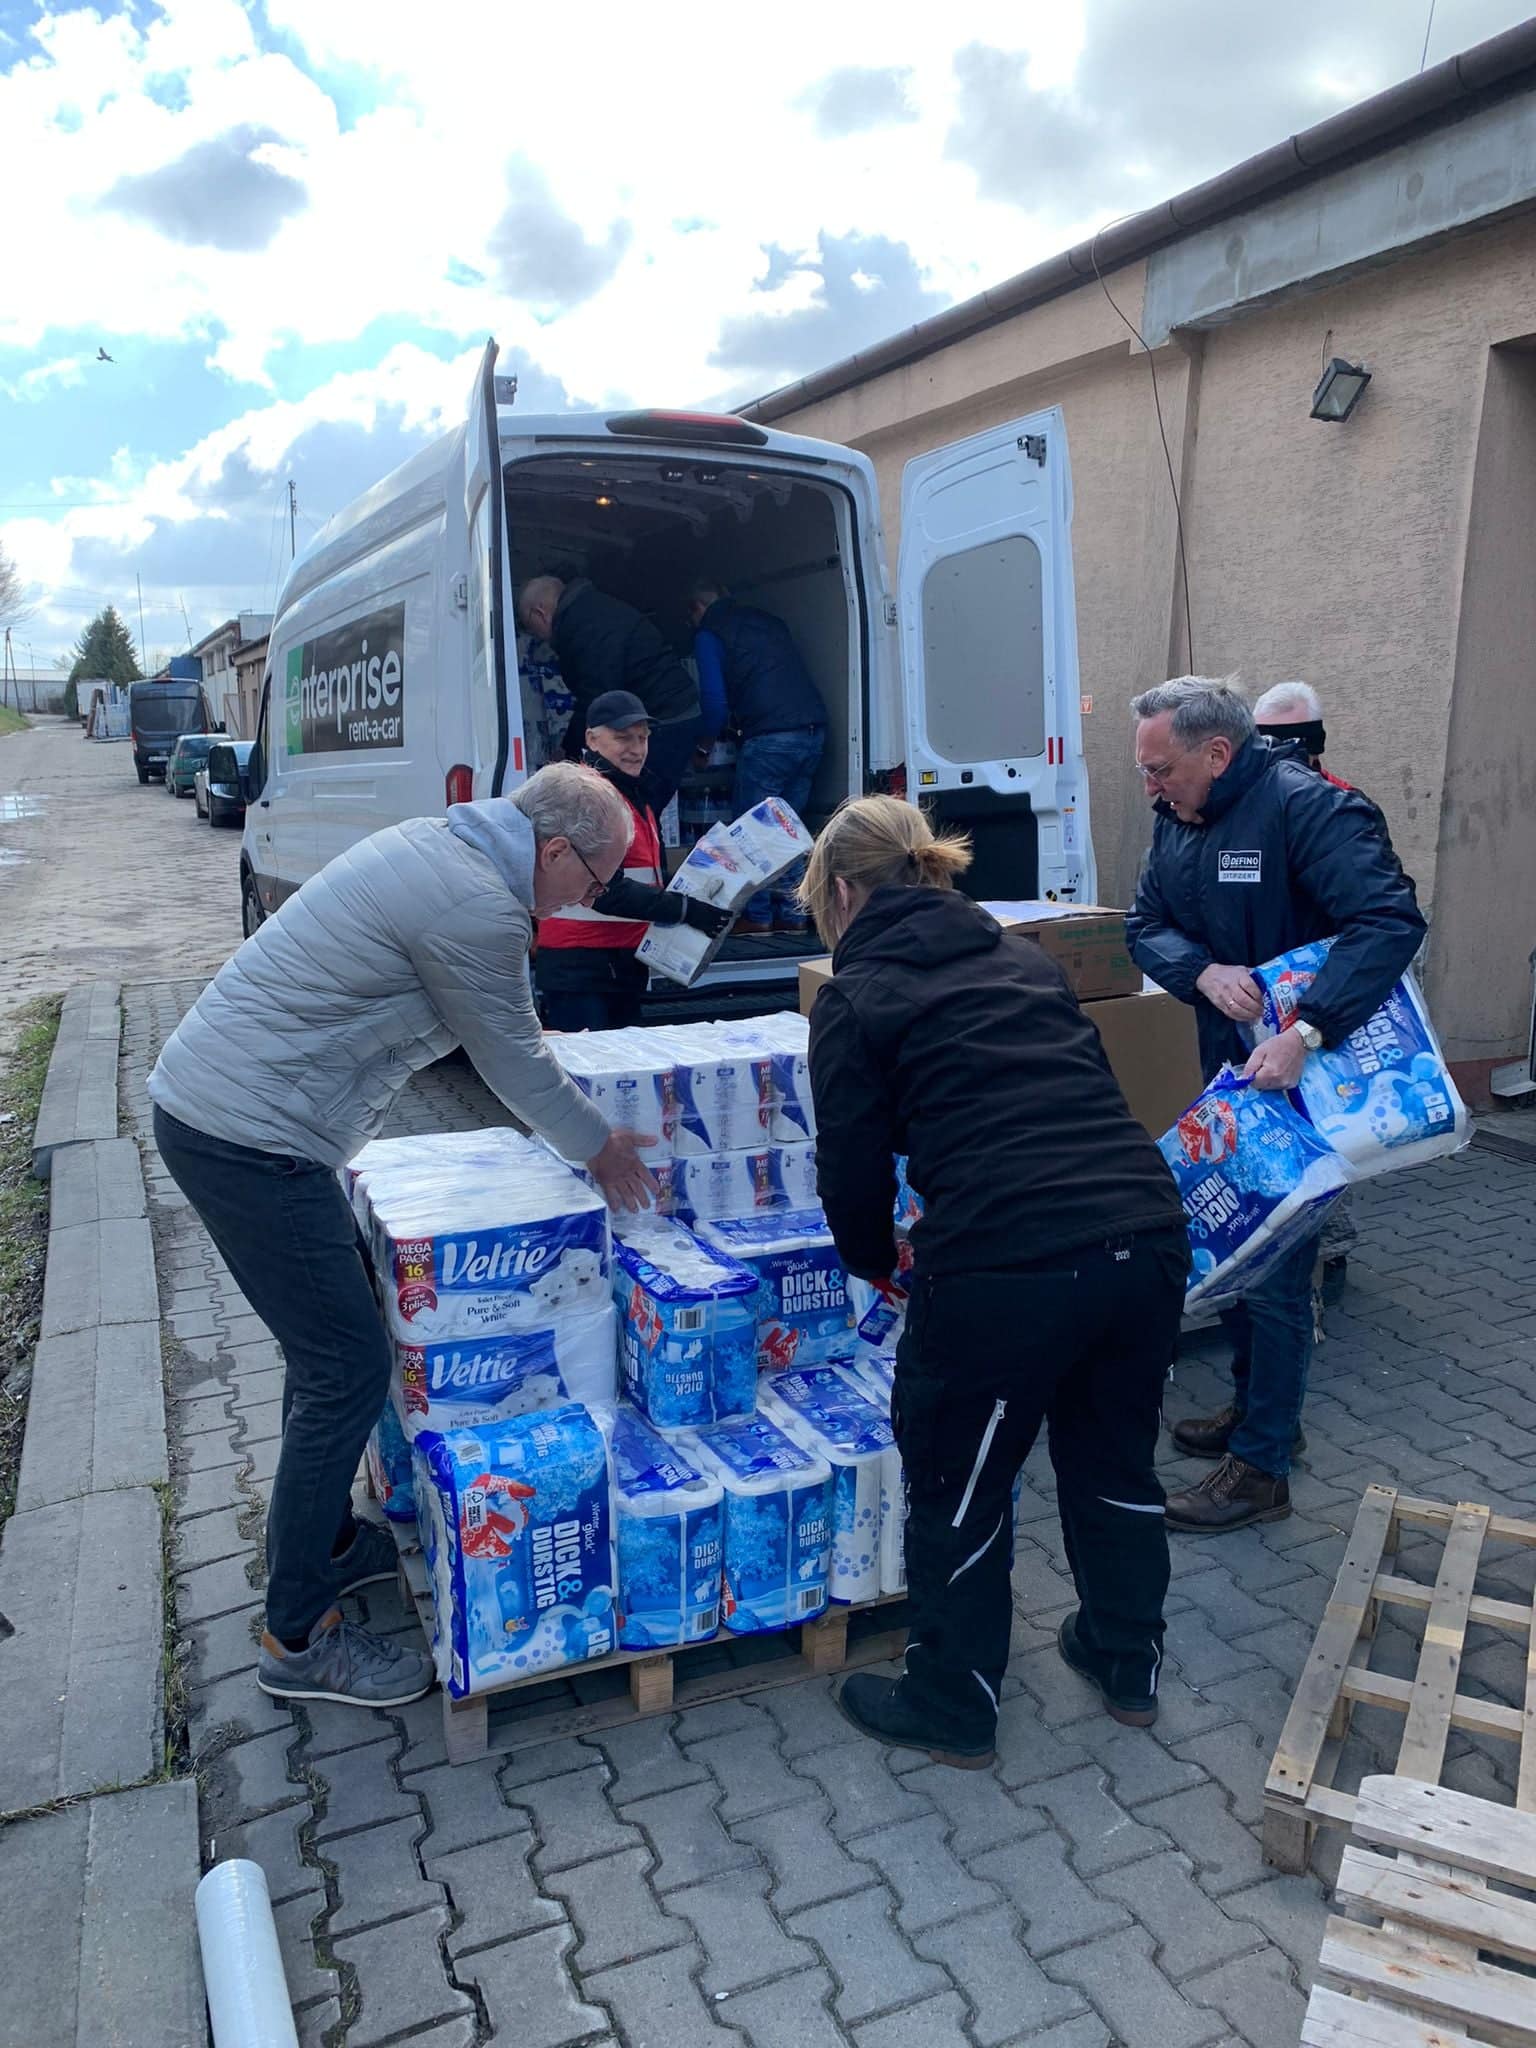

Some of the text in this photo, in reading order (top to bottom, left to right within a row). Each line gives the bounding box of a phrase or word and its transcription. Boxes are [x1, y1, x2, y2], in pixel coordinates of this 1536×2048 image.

[287, 639, 401, 733] enterprise
[348, 715, 401, 742] rent-a-car
[1367, 1005, 1399, 1051] ICK
[1182, 1170, 1227, 1217] DURSTI
[1198, 1186, 1240, 1232] DICK
[396, 1242, 432, 1254] MEGA
[399, 1252, 431, 1264] PACK
[404, 1264, 425, 1277] 16
[442, 1239, 547, 1286] Veltie
[781, 1268, 845, 1298] DICK &
[467, 1300, 521, 1316] Pure & Soft
[782, 1290, 846, 1315] DURSTIG
[480, 1312, 507, 1324] White
[404, 1352, 424, 1361] EGA
[431, 1352, 518, 1390] Veltie
[676, 1382, 703, 1396] DICK
[800, 1518, 825, 1537] DICK
[553, 1519, 583, 1602] DICK &
[694, 1540, 719, 1559] DICK
[532, 1526, 557, 1609] DURSTIG
